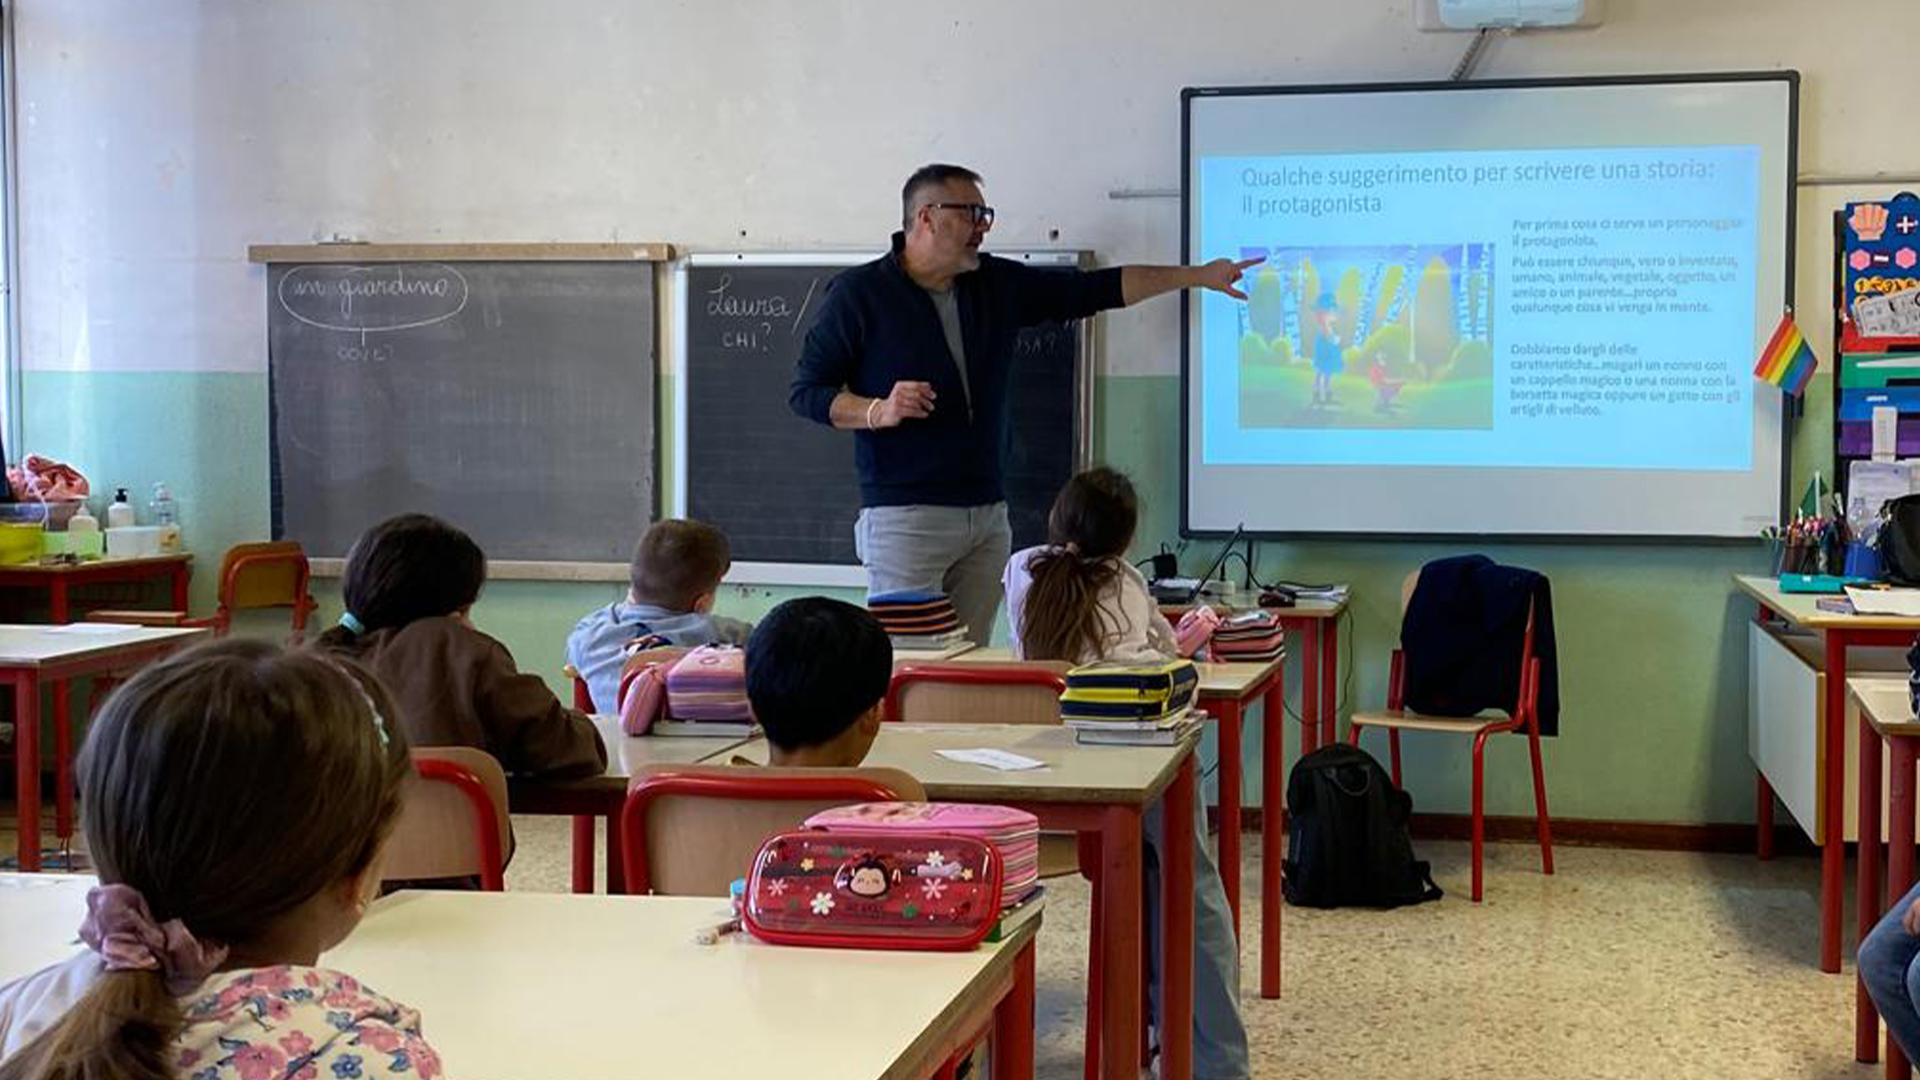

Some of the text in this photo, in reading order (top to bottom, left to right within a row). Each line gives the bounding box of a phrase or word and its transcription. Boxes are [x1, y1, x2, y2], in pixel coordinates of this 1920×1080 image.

[1242, 159, 1715, 188] Qualche suggerimento per scrivere una storia:
[1257, 194, 1382, 217] protagonista
[1512, 218, 1531, 232] Per
[1534, 218, 1569, 232] prima
[1571, 218, 1597, 232] cosa
[1613, 218, 1646, 232] serve
[1537, 256, 1575, 269] essere
[706, 271, 793, 318] Laura
[721, 321, 772, 352] CHI?
